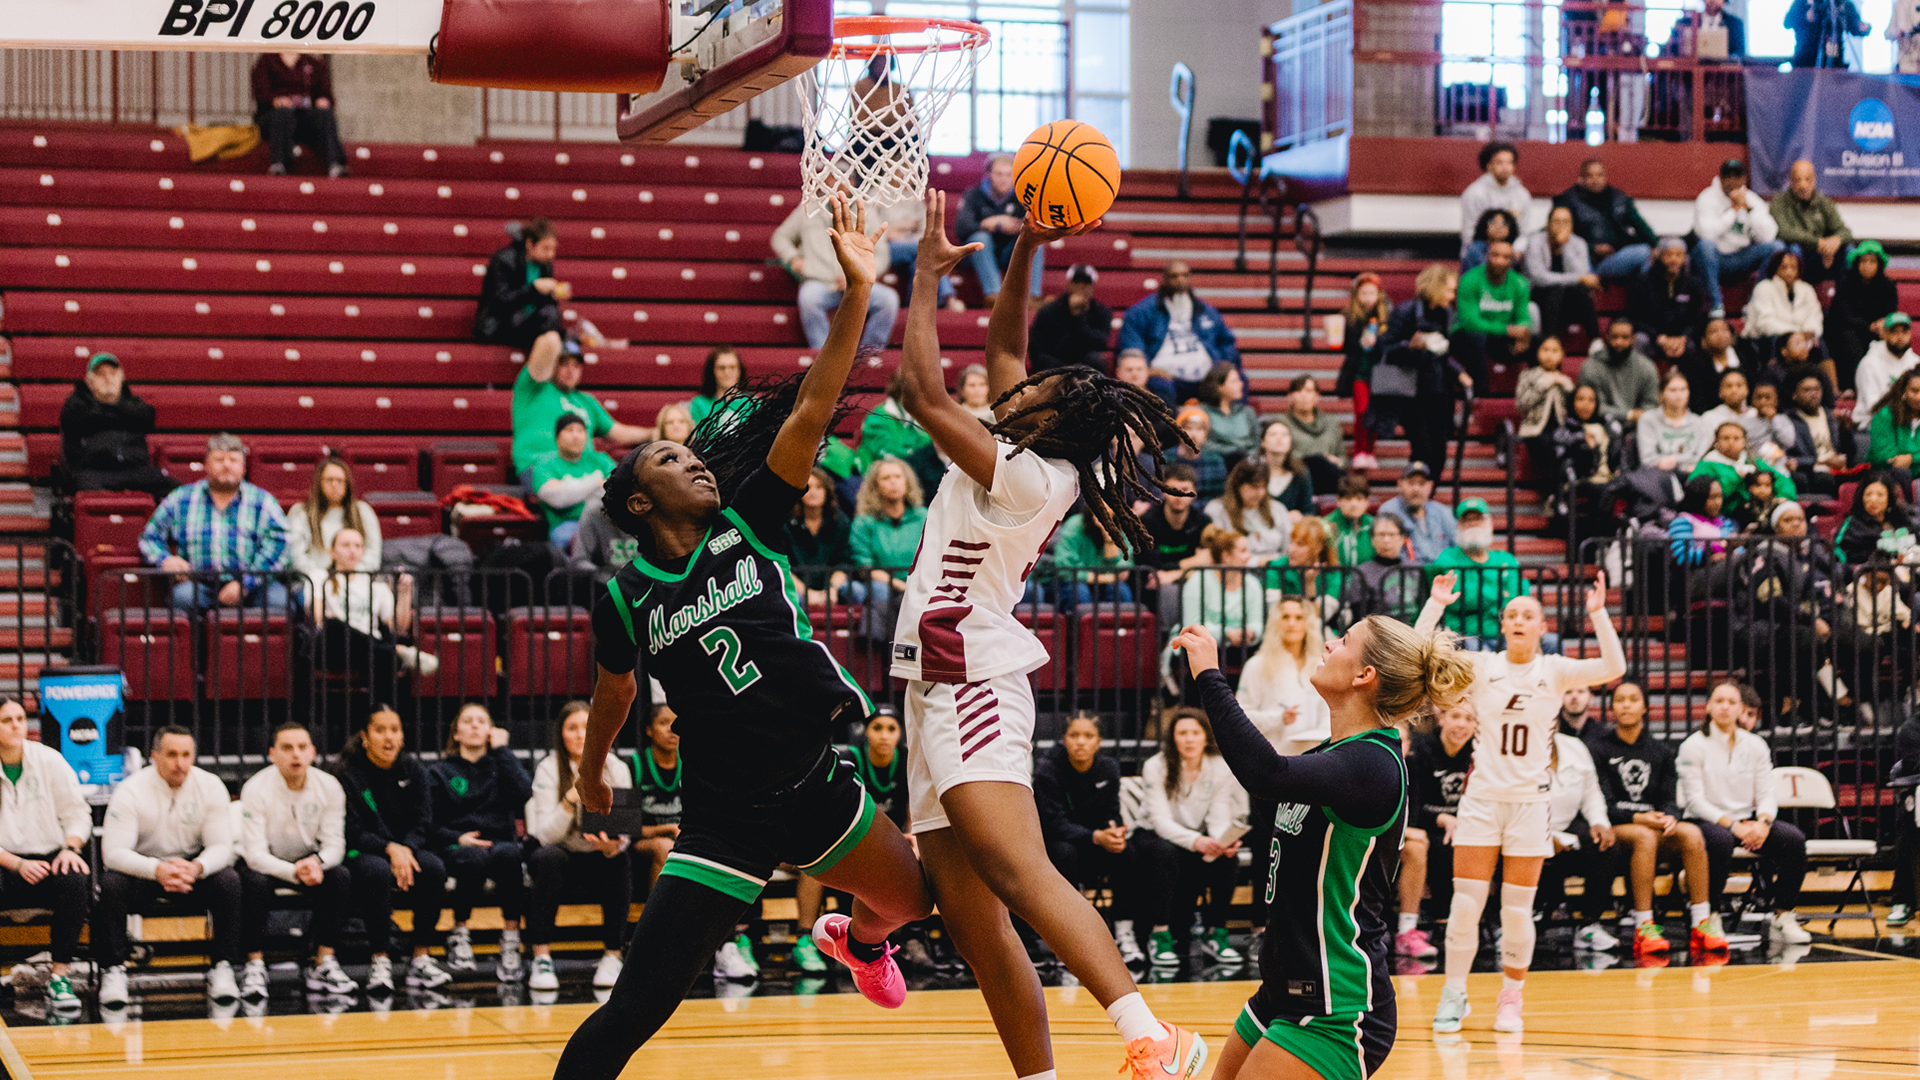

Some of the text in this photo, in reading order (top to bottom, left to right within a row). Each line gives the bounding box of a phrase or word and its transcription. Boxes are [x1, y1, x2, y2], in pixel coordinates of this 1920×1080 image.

[158, 0, 375, 41] BPI 8000
[1854, 120, 1894, 139] NCAA
[708, 528, 742, 555] SBC
[649, 555, 763, 655] Marshall
[698, 626, 763, 695] 2
[1504, 694, 1532, 711] E
[1501, 723, 1529, 756] 10
[1784, 773, 1804, 798] T
